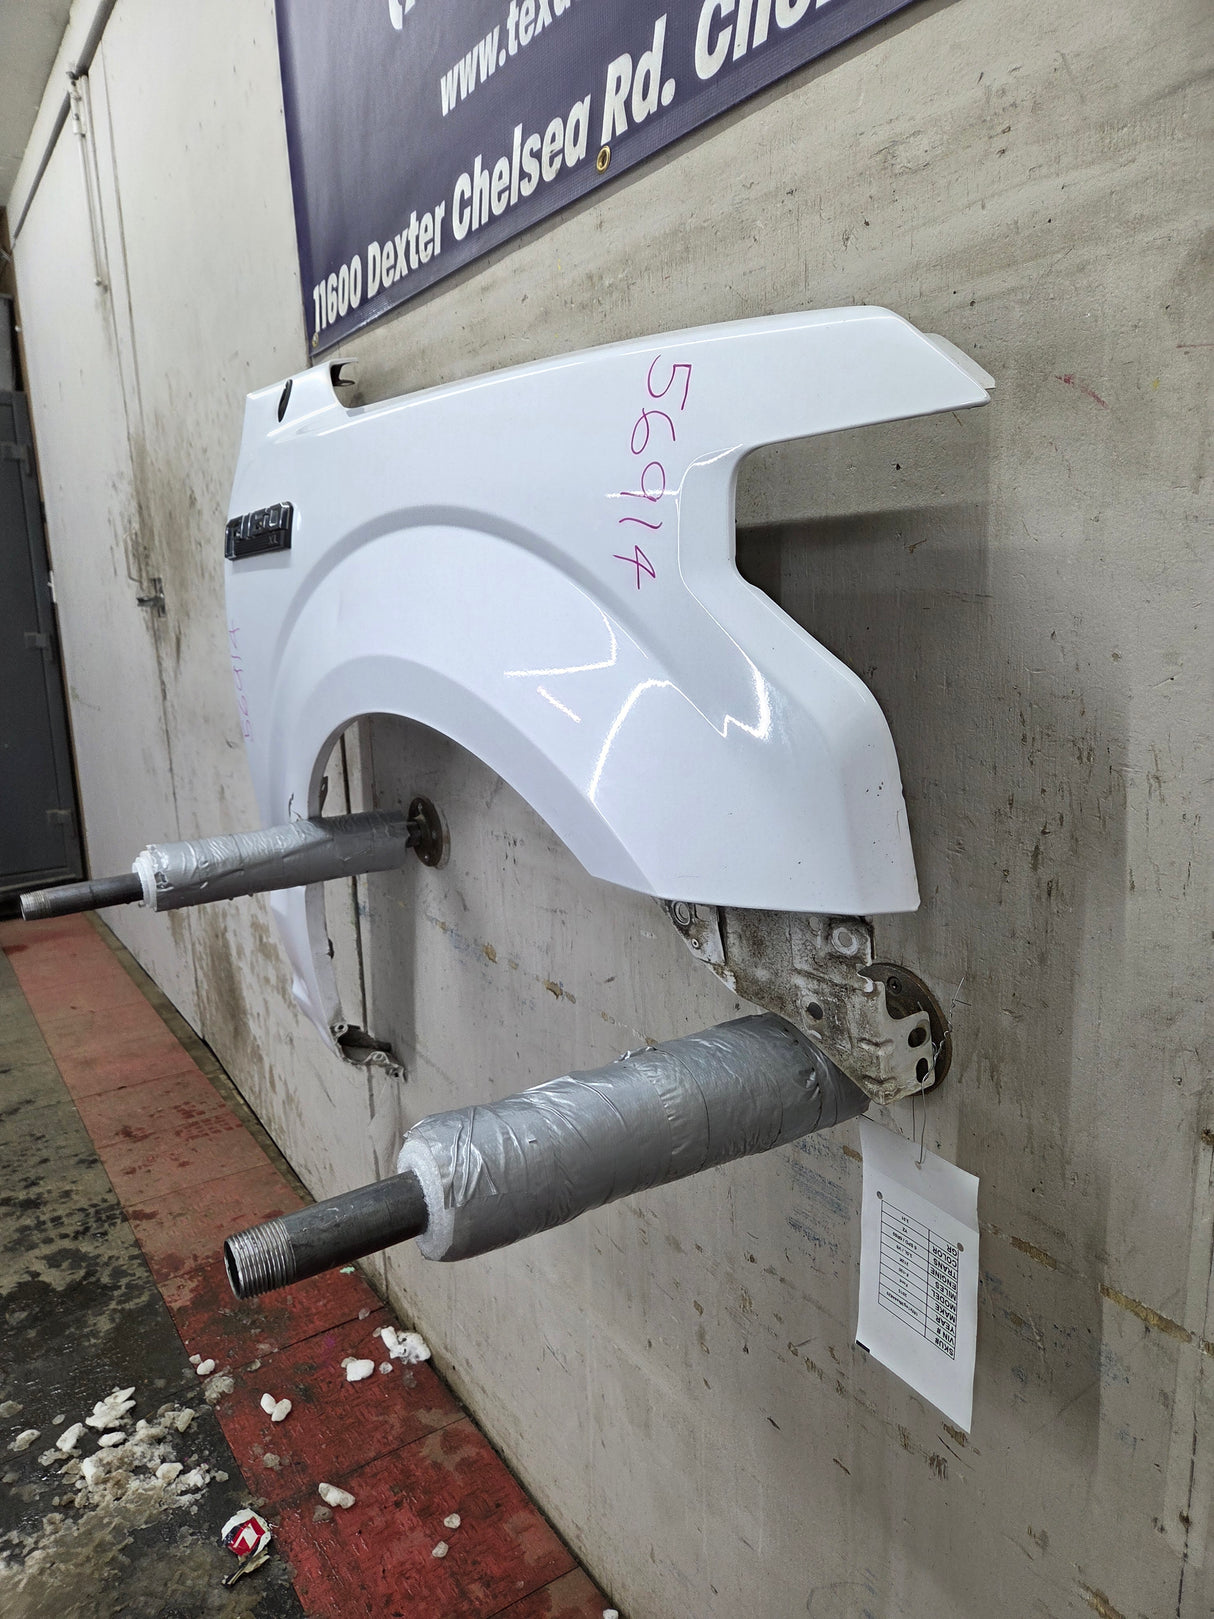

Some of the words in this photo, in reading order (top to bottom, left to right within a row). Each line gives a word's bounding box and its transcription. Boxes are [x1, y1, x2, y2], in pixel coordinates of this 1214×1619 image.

[313, 255, 362, 333] 11600
[367, 200, 445, 299] Dexter
[452, 94, 592, 241] Chelsea
[601, 13, 676, 147] Rd.
[613, 354, 692, 590] 56914
[932, 1245, 957, 1268] COLOR
[946, 1243, 957, 1257] GR
[929, 1266, 956, 1290] ENGINE
[932, 1257, 956, 1279] TRANS
[930, 1288, 956, 1312] MODEL
[934, 1280, 956, 1301] MILES
[934, 1302, 955, 1323] MAKE
[935, 1314, 954, 1334] YEAR
[934, 1335, 953, 1357] SKU#
[942, 1330, 954, 1345] VIN
